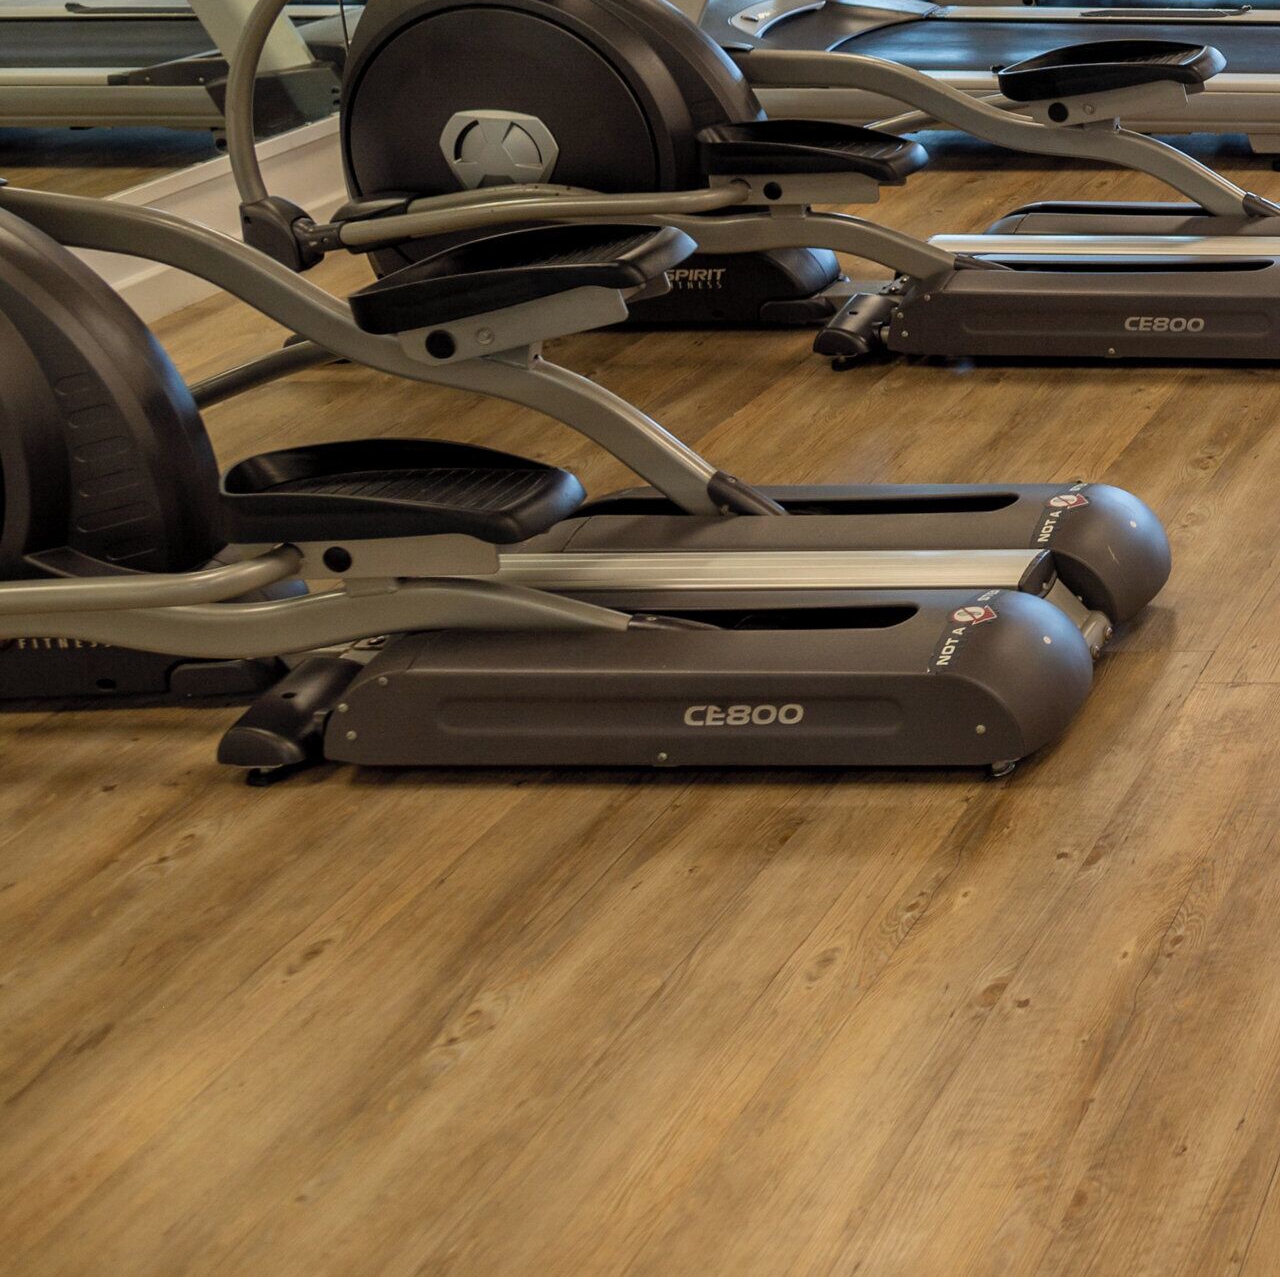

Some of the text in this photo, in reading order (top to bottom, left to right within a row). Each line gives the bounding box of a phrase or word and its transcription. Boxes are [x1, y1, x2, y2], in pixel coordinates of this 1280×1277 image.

[667, 268, 726, 281] SPIRIT
[1124, 316, 1205, 332] CE800
[1037, 510, 1063, 542] NOT A
[18, 638, 111, 650] FITNE
[936, 626, 967, 665] NOT A
[683, 703, 805, 726] CE800
